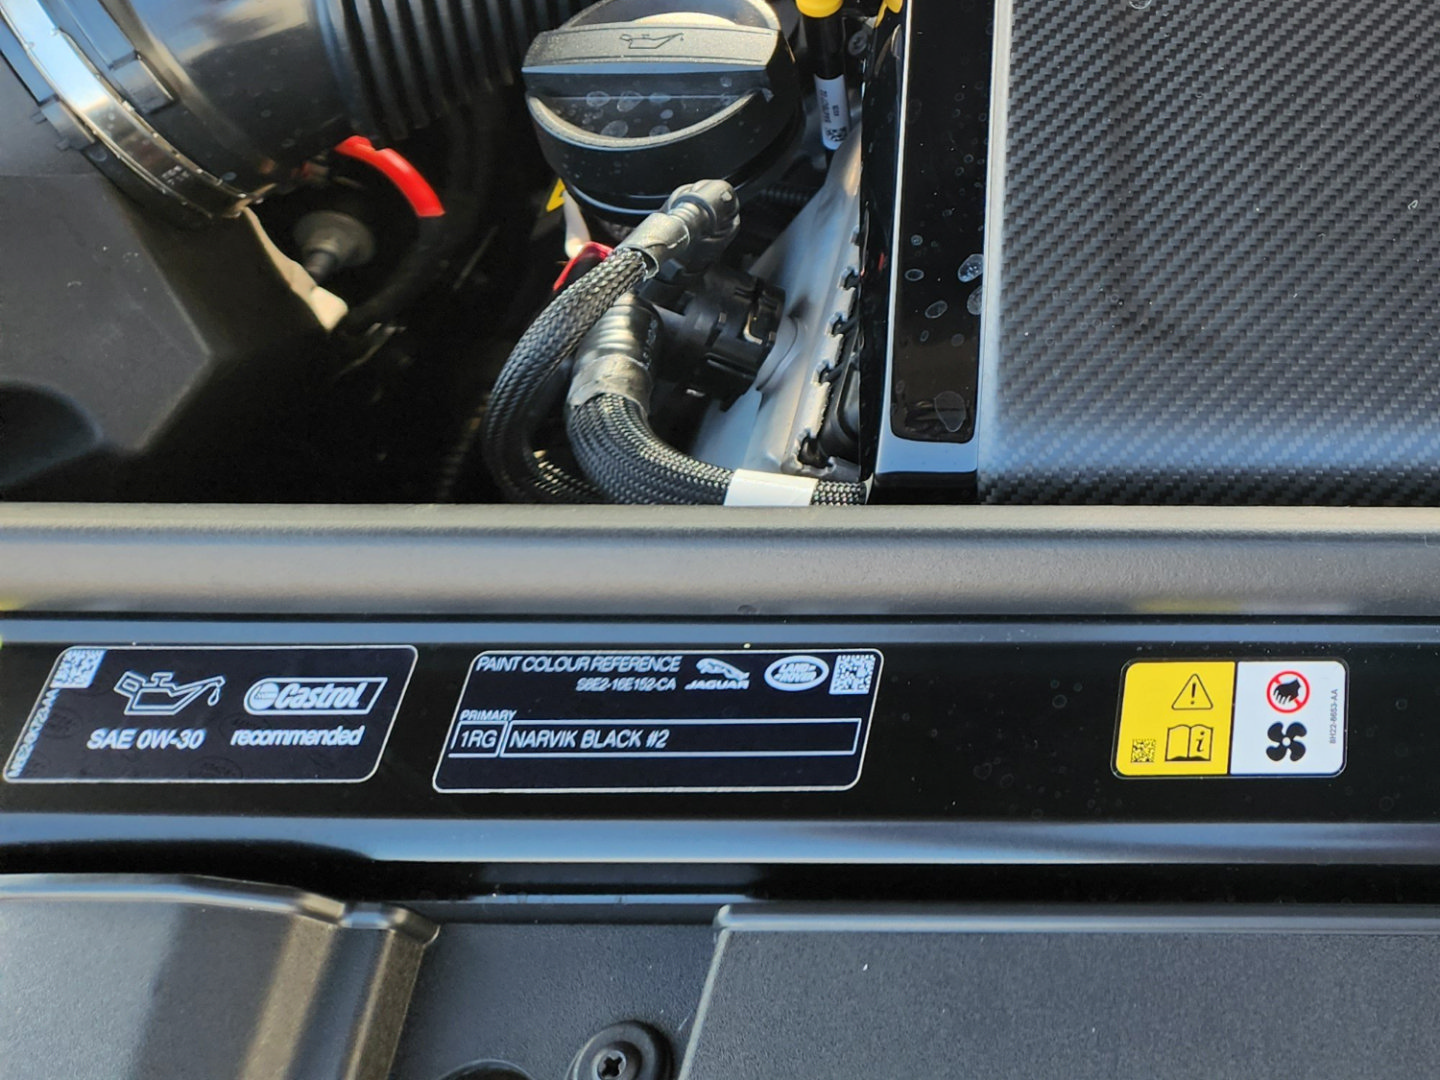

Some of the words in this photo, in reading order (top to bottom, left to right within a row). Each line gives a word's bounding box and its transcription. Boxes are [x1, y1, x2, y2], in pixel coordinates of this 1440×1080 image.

[475, 656, 522, 672] PAINT
[522, 656, 590, 672] COLOUR
[590, 655, 682, 672] REFERENCE
[684, 679, 750, 690] JAGUAR
[274, 683, 367, 709] Castrol
[460, 709, 517, 720] PRIMARY
[87, 729, 136, 749] SAE
[137, 728, 205, 750] 0W-30
[230, 726, 365, 747] recommended
[460, 730, 498, 749] 1RG
[509, 729, 576, 749] NARVIK
[580, 729, 642, 749] BLACK
[646, 729, 670, 749] #2
